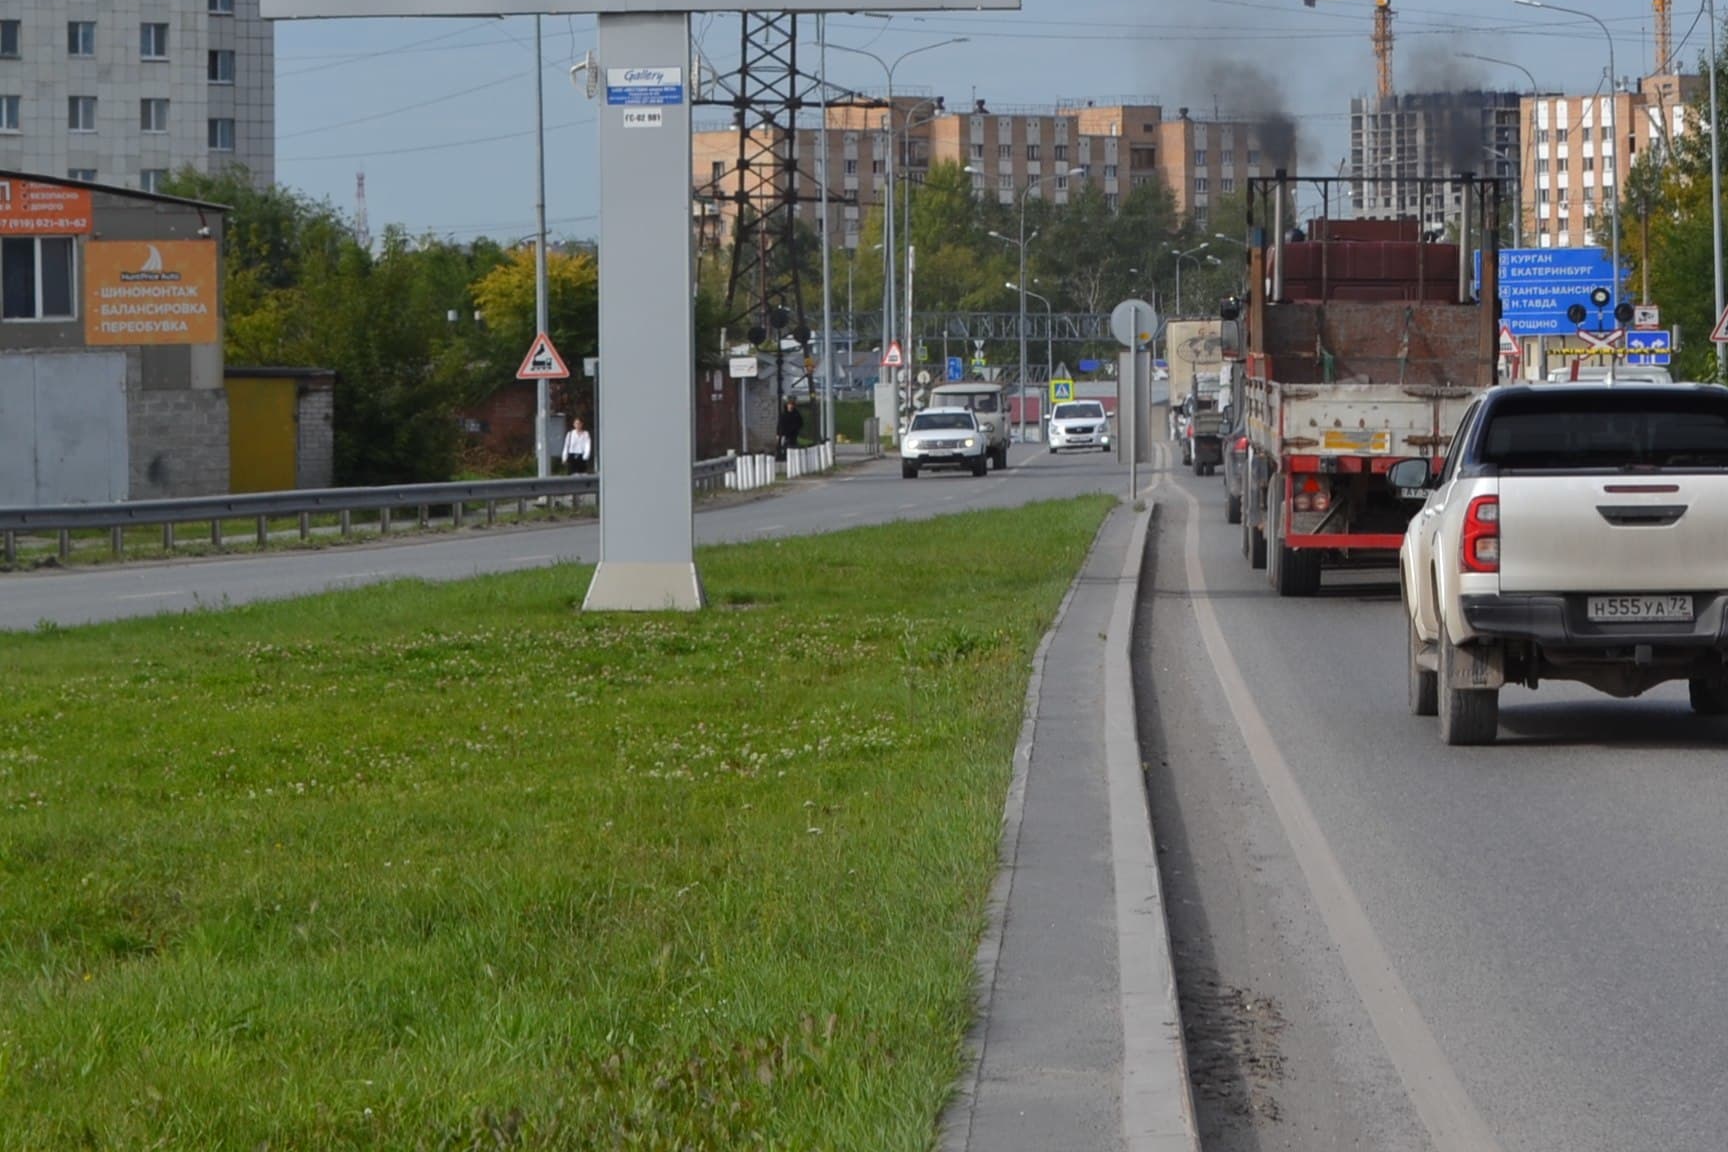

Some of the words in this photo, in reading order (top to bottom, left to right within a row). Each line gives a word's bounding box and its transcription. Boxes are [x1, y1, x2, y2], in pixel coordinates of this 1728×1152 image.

[1511, 254, 1552, 264] КУРГАН
[1511, 266, 1593, 277] ЕКАТЕРИНБУРГ
[101, 286, 198, 298] ШИНОМОНТАЖ
[101, 303, 207, 315] БАЛАНСИРОВКА
[1512, 299, 1557, 309] Н.ТАВДА
[101, 320, 188, 333] ПЕРЕОБУВКА
[1512, 319, 1557, 329] РОЩИНО
[1594, 598, 1665, 617] Н555УА
[1670, 597, 1688, 611] 72
